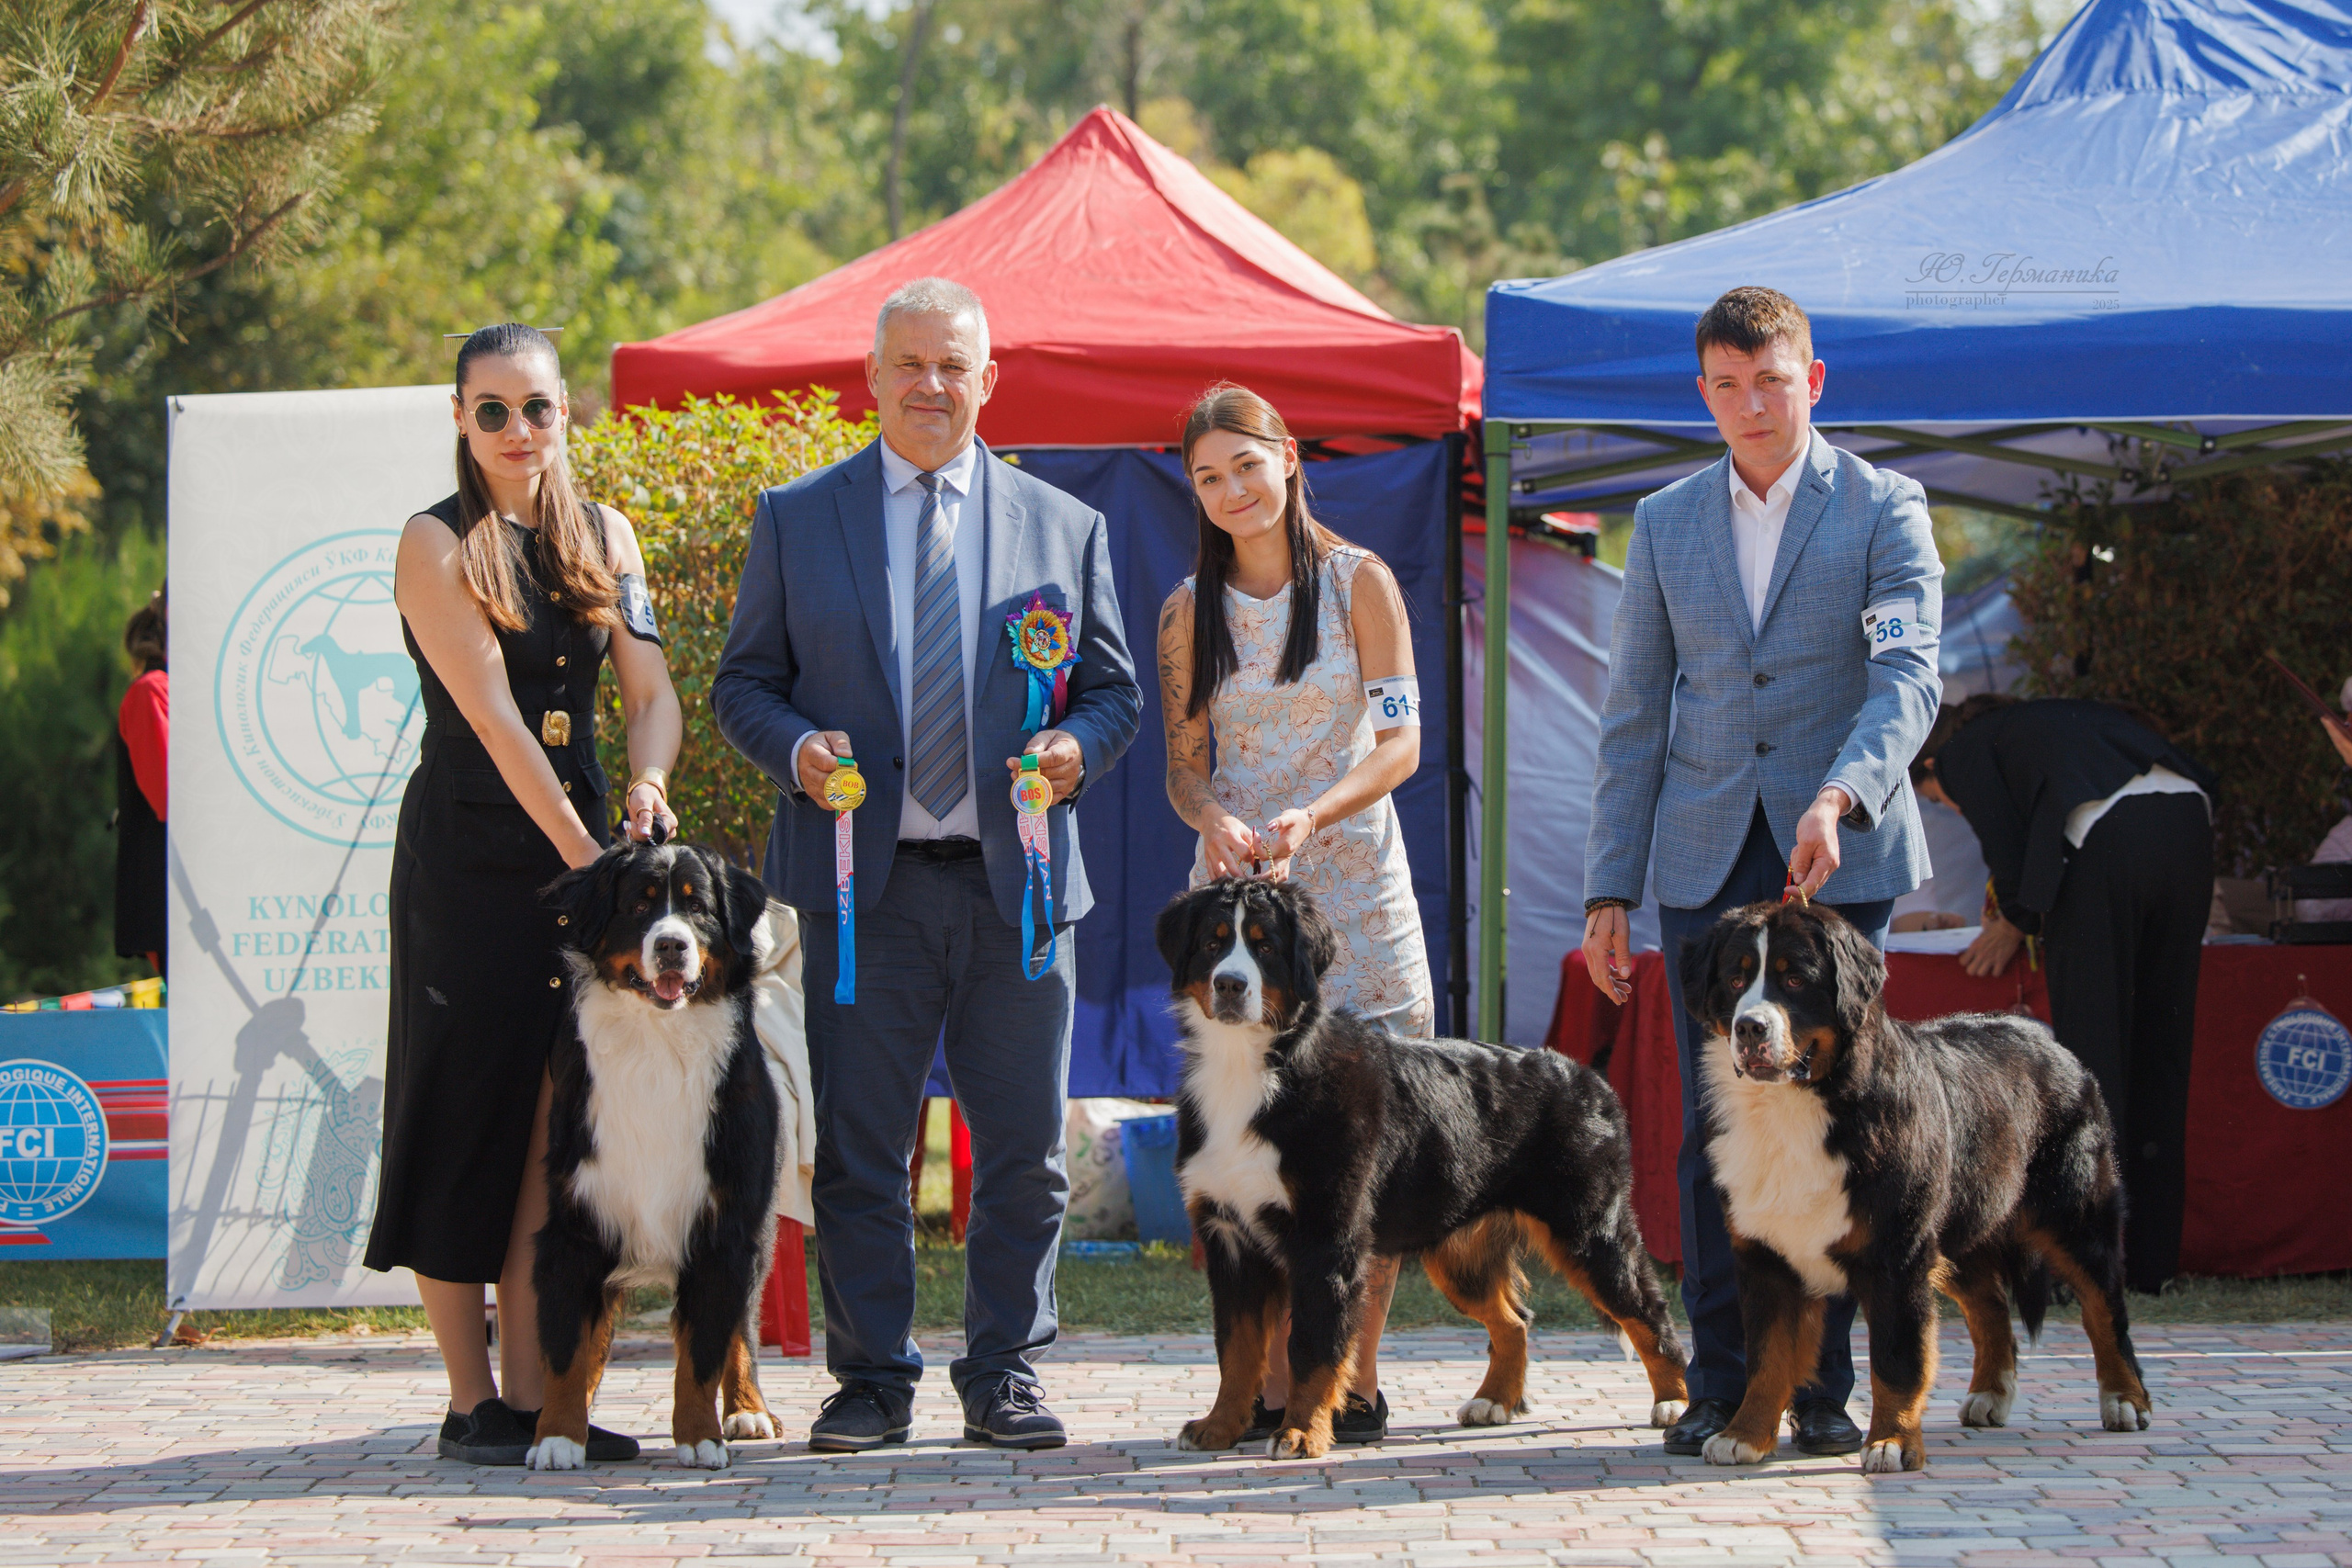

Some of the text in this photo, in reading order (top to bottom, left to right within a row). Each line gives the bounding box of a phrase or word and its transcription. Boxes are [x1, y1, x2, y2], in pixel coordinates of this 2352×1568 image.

[239, 563, 321, 657] Федерацияси
[1876, 617, 1904, 643] 58
[236, 661, 261, 757] Кинологик
[1383, 694, 1409, 718] 61
[842, 780, 859, 789] BOB
[1020, 787, 1042, 802] BOS
[2288, 1047, 2326, 1072] FCI
[41, 1085, 101, 1213] INTERNATIONALE
